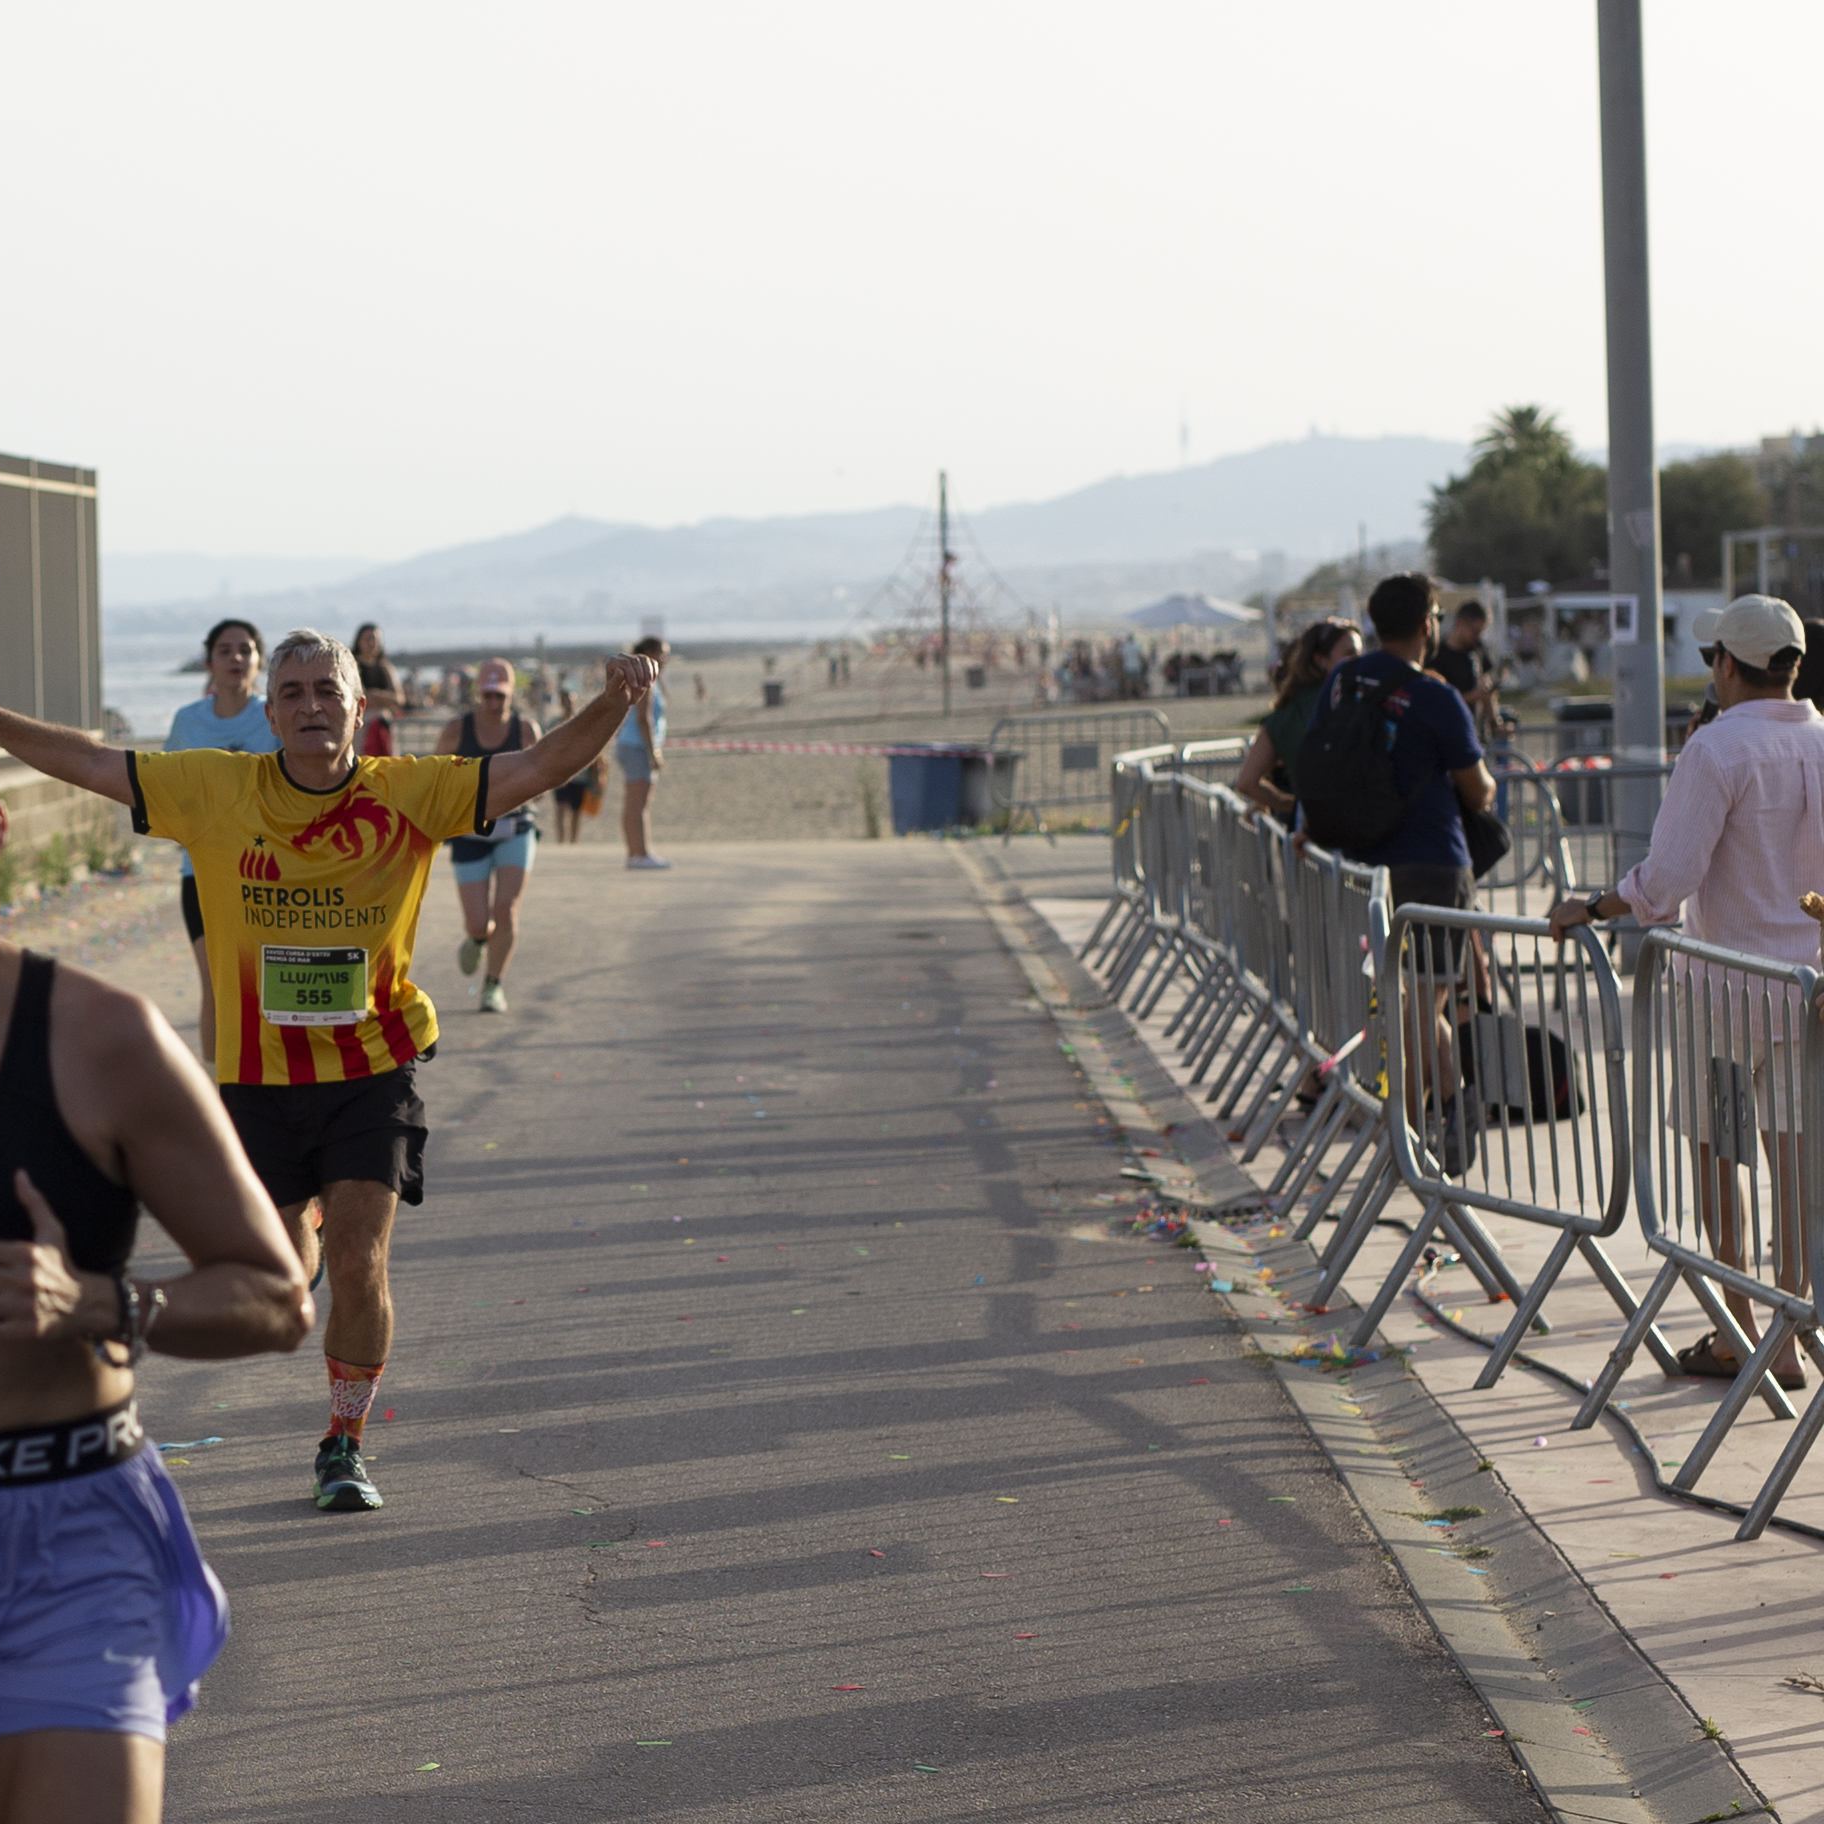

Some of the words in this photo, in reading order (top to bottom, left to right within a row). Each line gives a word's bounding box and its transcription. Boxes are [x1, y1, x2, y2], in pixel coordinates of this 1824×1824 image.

[241, 884, 345, 907] PETROLIS
[244, 904, 387, 929] INDEPENDENTS
[347, 952, 360, 961] 5K
[296, 989, 332, 1005] 555
